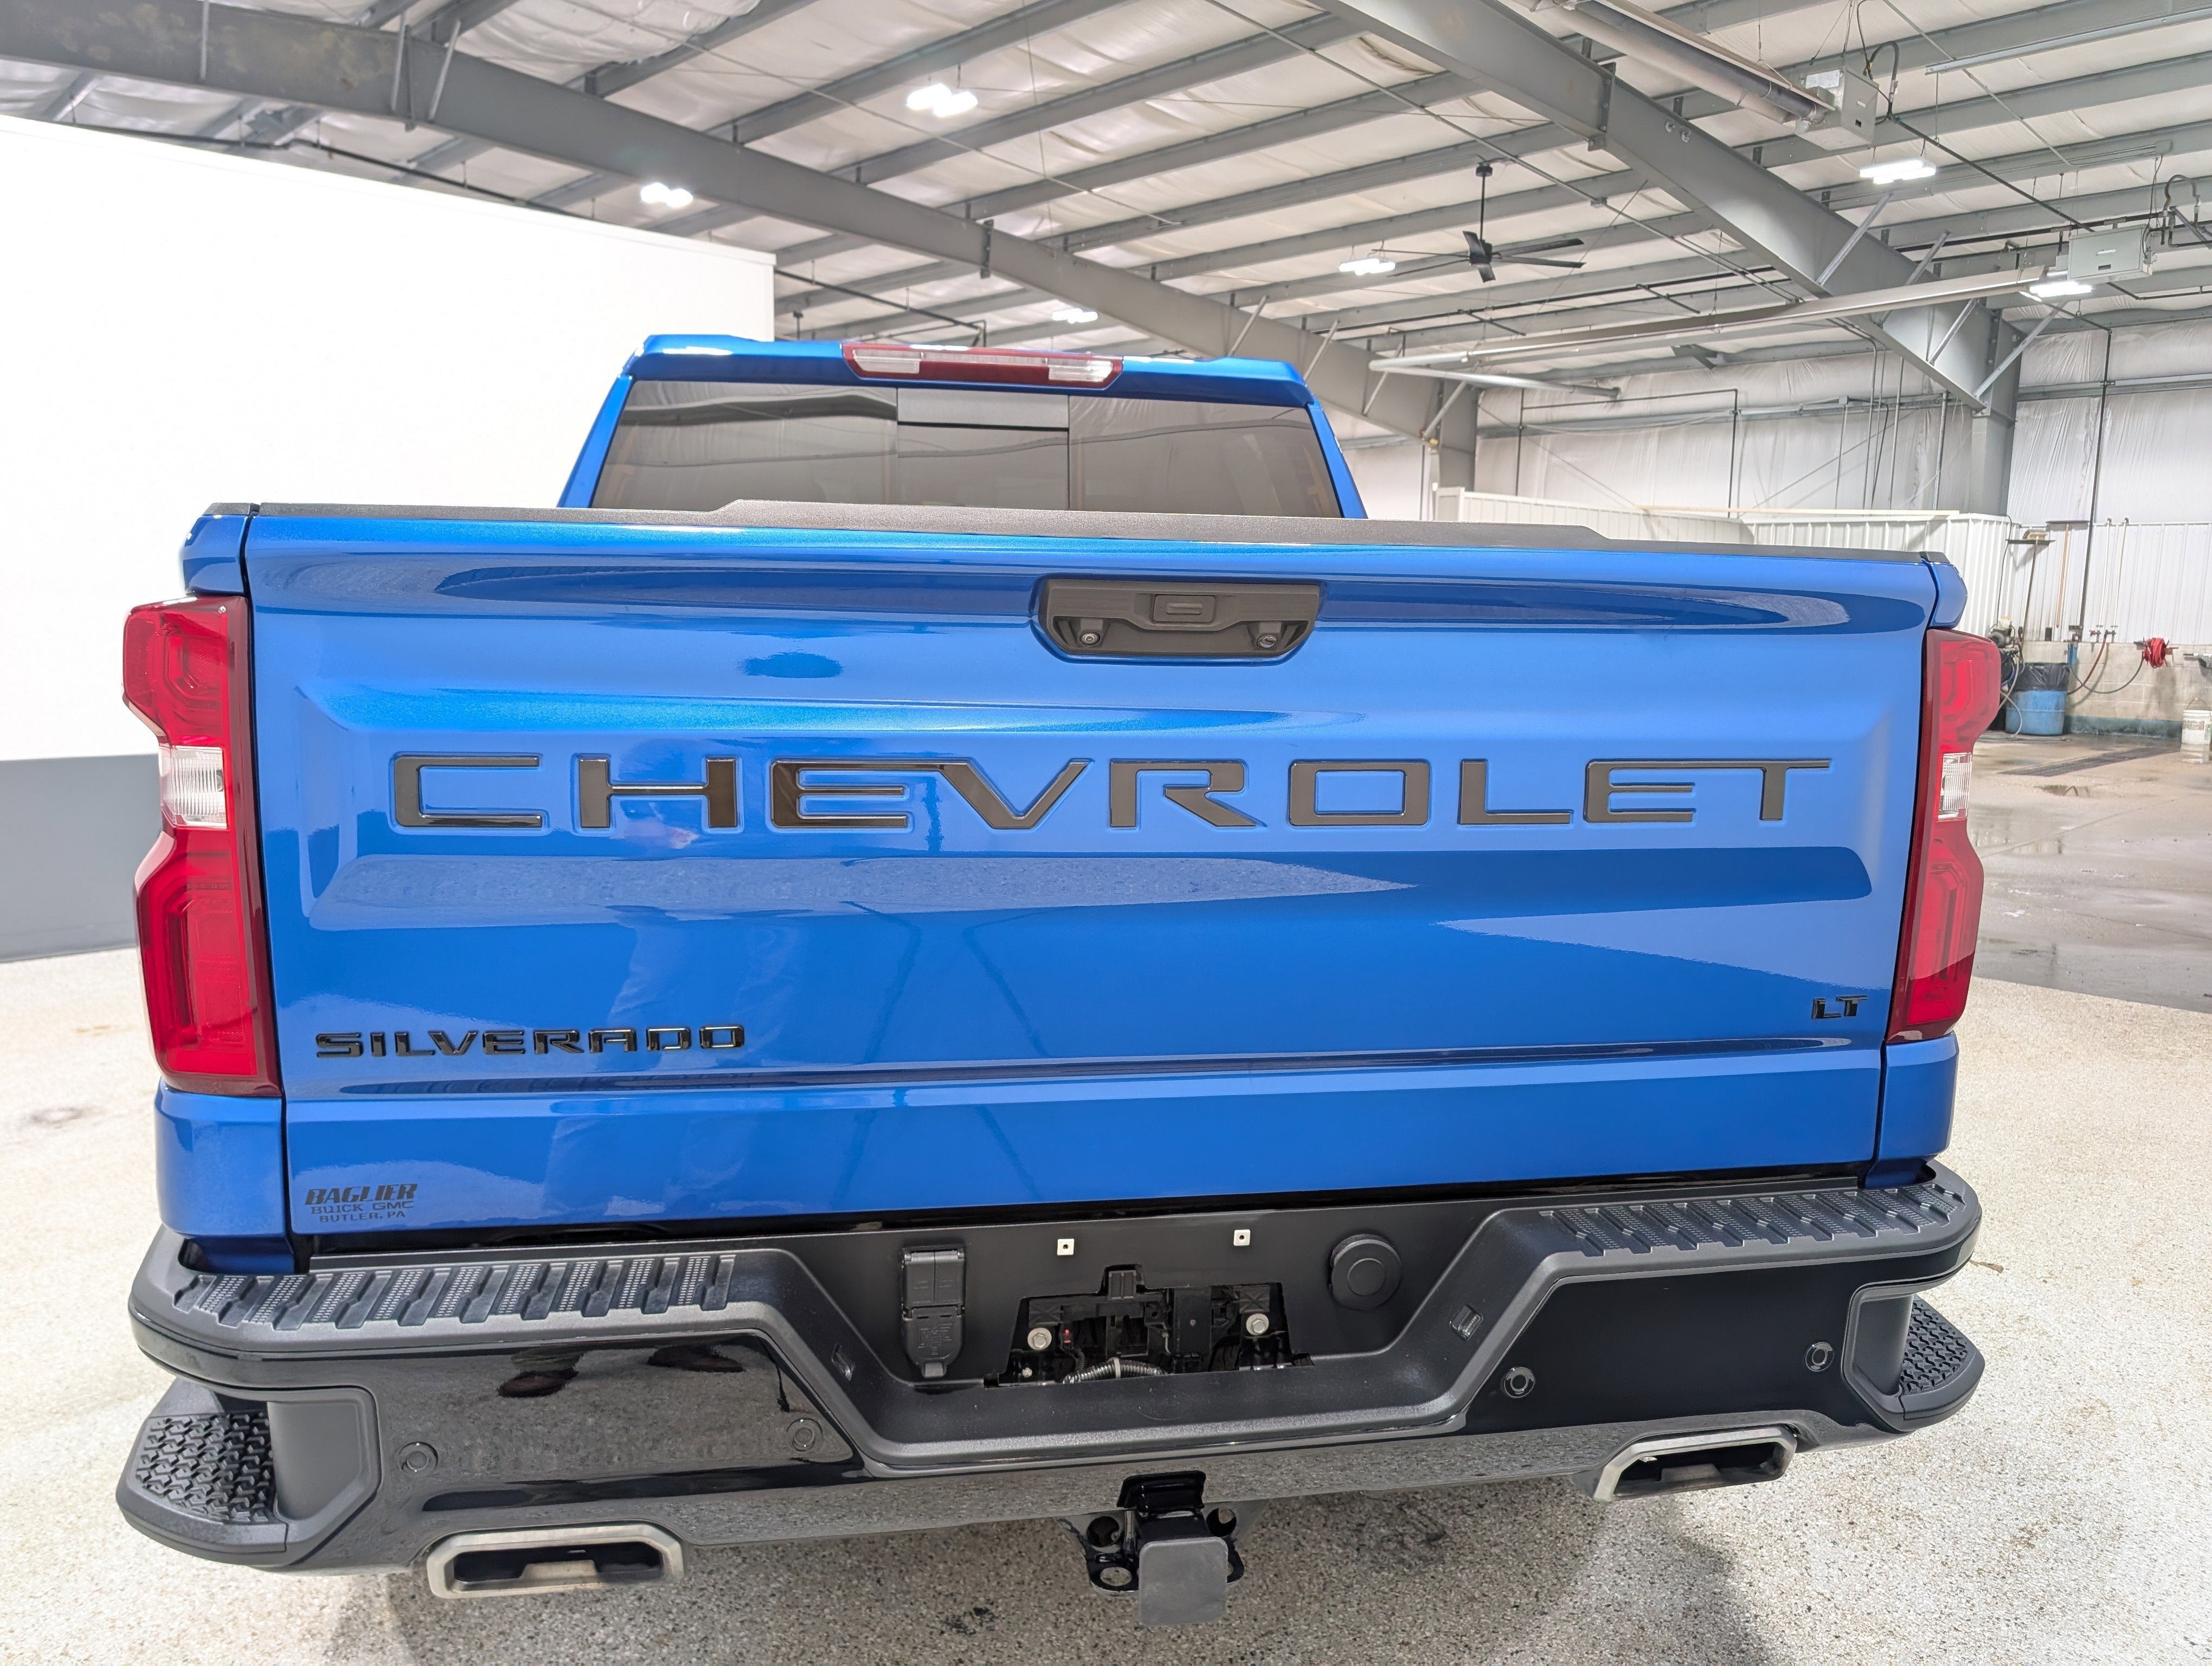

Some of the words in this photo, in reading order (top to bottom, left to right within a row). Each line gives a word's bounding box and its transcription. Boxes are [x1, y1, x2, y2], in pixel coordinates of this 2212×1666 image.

[394, 755, 1831, 829] CHEVROLET
[1811, 995, 1867, 1019] LT
[316, 1025, 745, 1058] SILVERADO
[305, 1183, 417, 1205] BAGLIER
[311, 1204, 363, 1214] BUICK
[372, 1200, 414, 1210] GMC
[387, 1210, 406, 1218] PA
